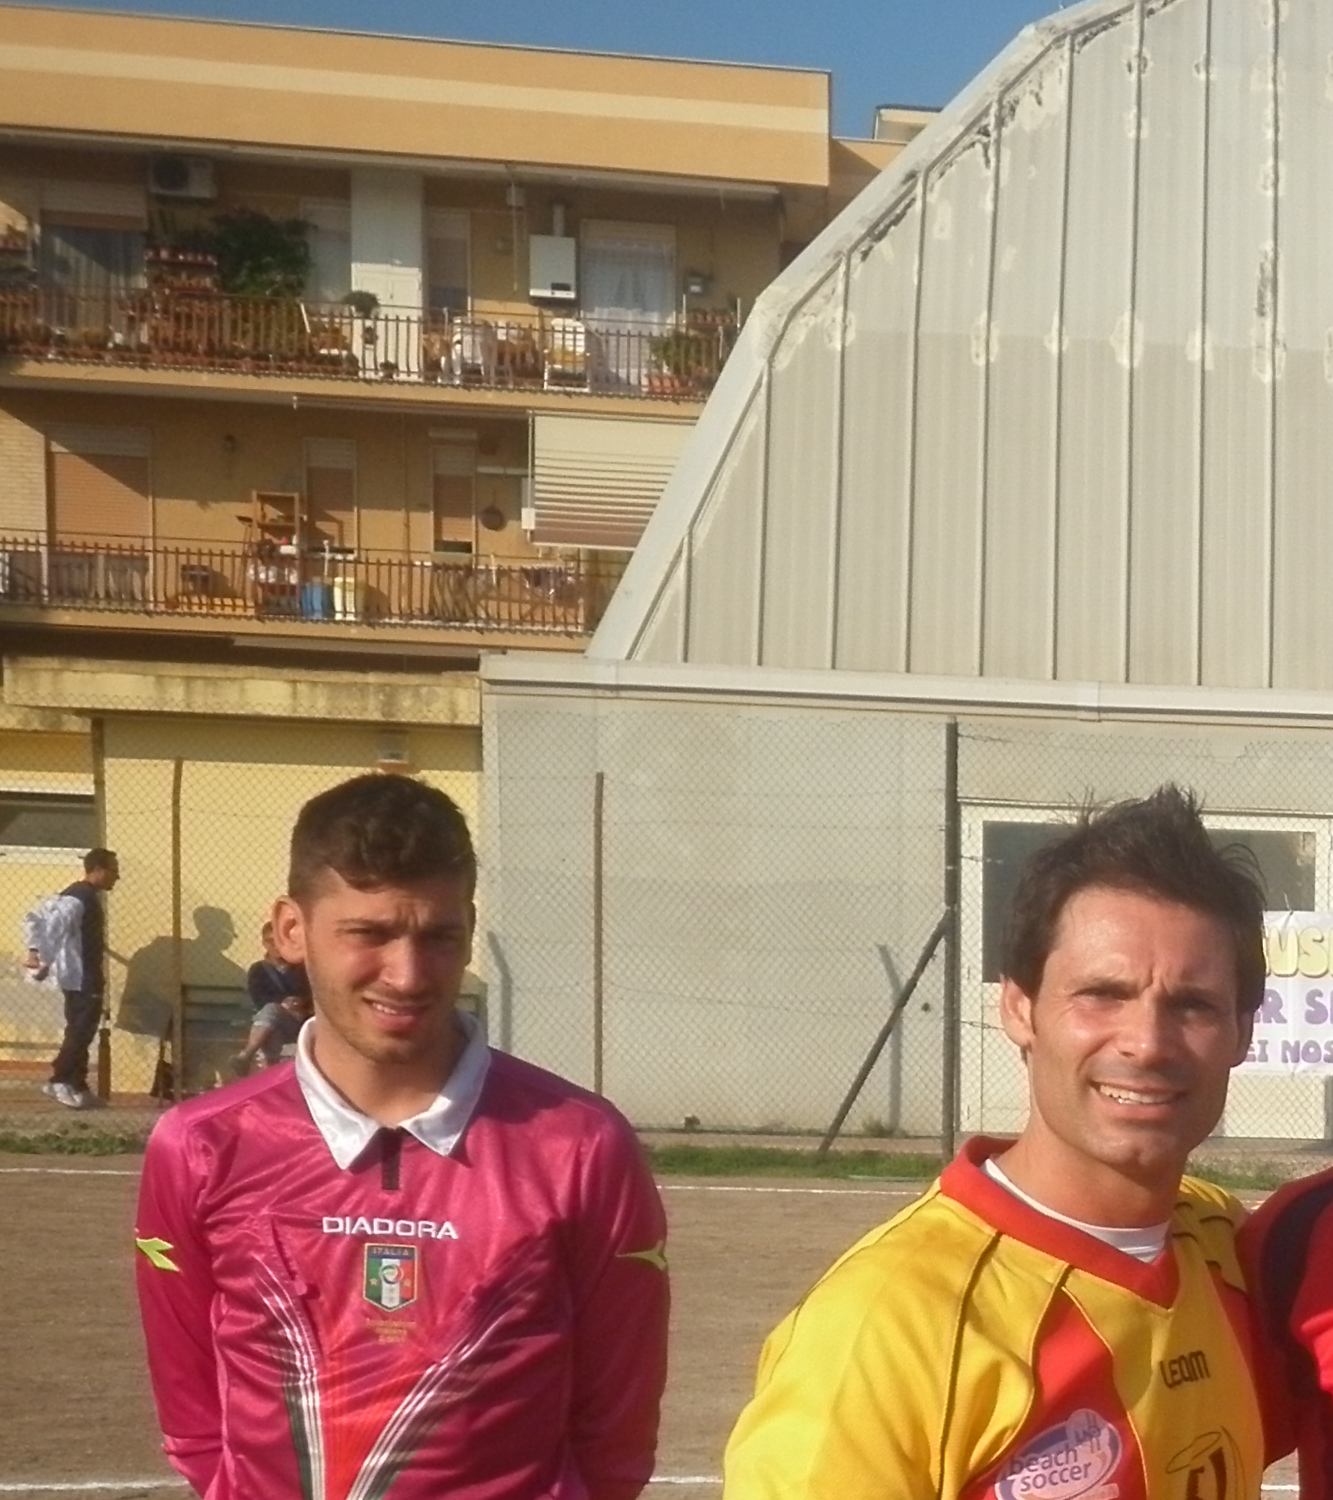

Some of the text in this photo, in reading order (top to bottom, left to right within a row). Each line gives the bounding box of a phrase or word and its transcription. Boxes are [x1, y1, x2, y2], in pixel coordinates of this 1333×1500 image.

[322, 1217, 459, 1239] DIADORA
[1010, 1443, 1078, 1473] beach
[1020, 1461, 1092, 1492] soccer
